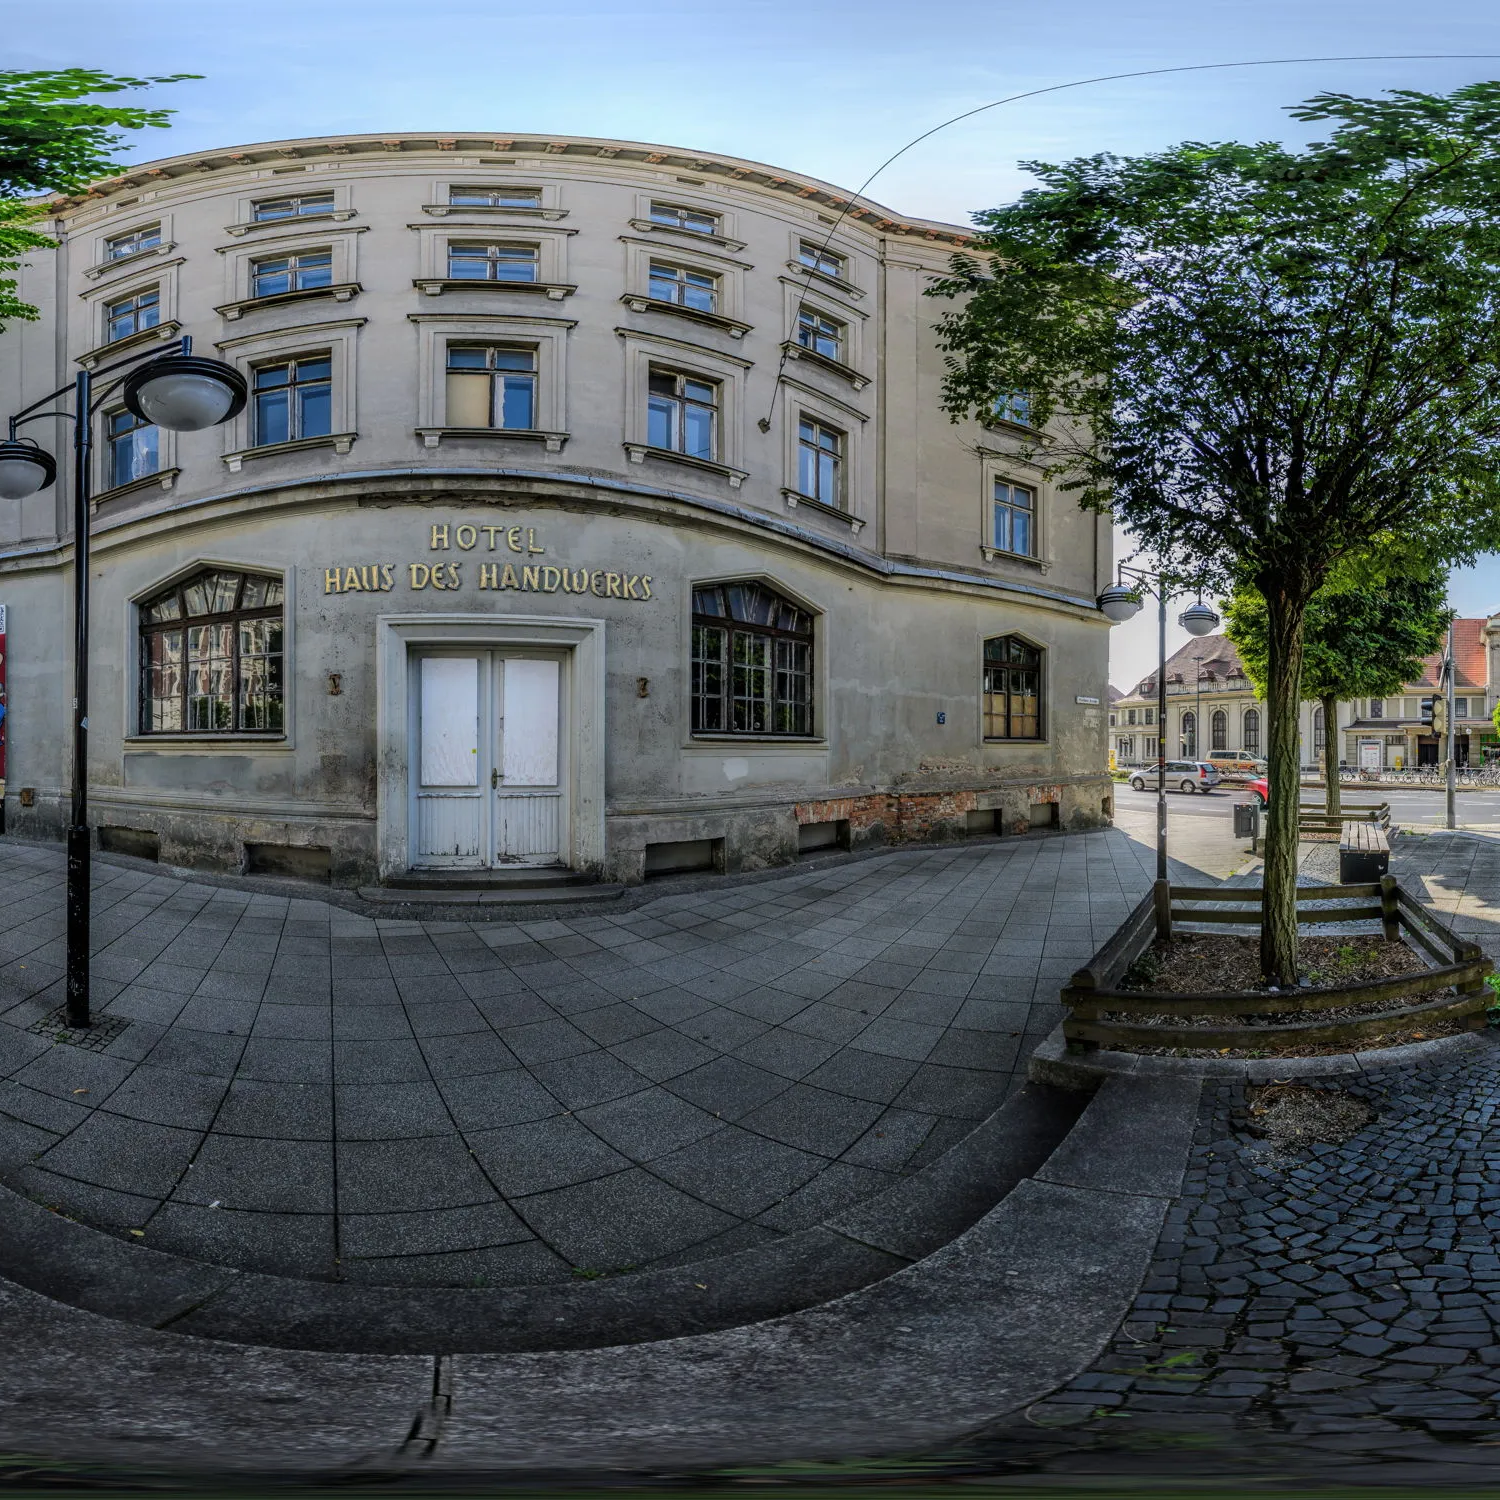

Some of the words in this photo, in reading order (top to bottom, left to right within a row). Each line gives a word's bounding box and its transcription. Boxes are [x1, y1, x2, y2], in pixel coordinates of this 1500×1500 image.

[430, 524, 545, 553] HOTEL
[324, 563, 396, 595] HAUS
[409, 561, 462, 590] DES
[479, 563, 653, 601] HANDWERKS
